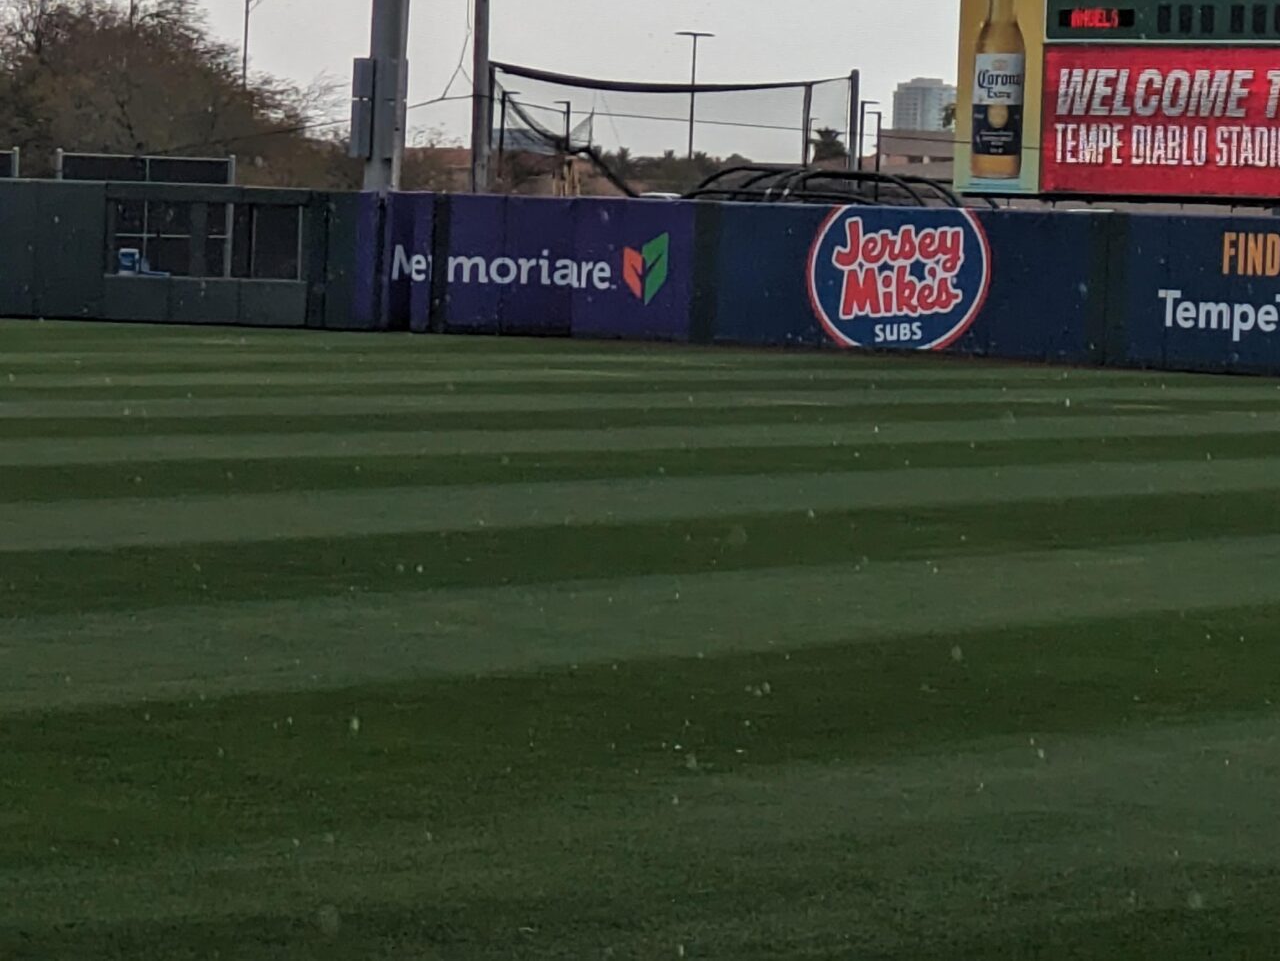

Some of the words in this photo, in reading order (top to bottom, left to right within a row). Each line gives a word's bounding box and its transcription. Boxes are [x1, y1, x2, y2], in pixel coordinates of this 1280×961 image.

[1056, 68, 1254, 117] WELCOME
[1054, 123, 1124, 164] TEMPE
[1131, 125, 1207, 166] DIABLO
[832, 217, 963, 273] Jersey
[1222, 231, 1280, 276] FIND
[840, 264, 963, 319] Mike's
[875, 322, 922, 342] SUBS
